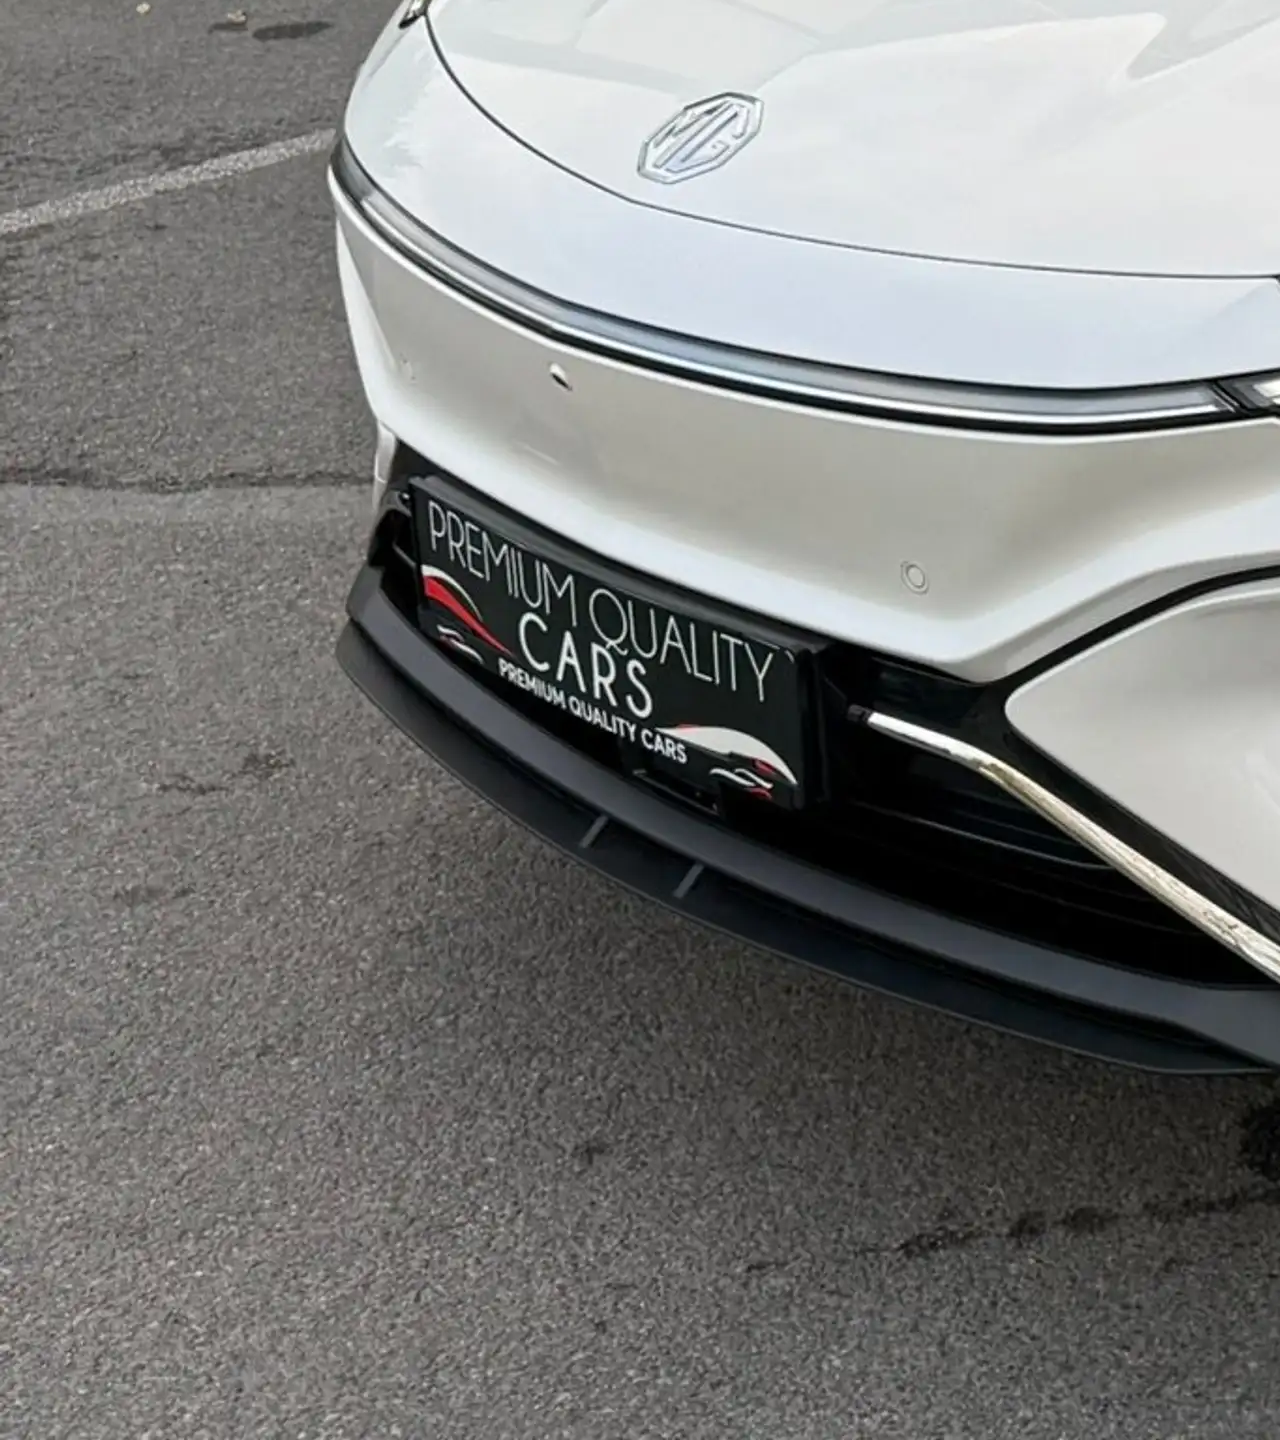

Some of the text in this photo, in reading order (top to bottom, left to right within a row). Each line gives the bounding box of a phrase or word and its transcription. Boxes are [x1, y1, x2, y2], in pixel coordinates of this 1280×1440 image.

[428, 499, 774, 703] PREMIUM QUALITY
[498, 657, 689, 765] PREMIUM QUALITY CARS
[518, 612, 653, 719] CARS
